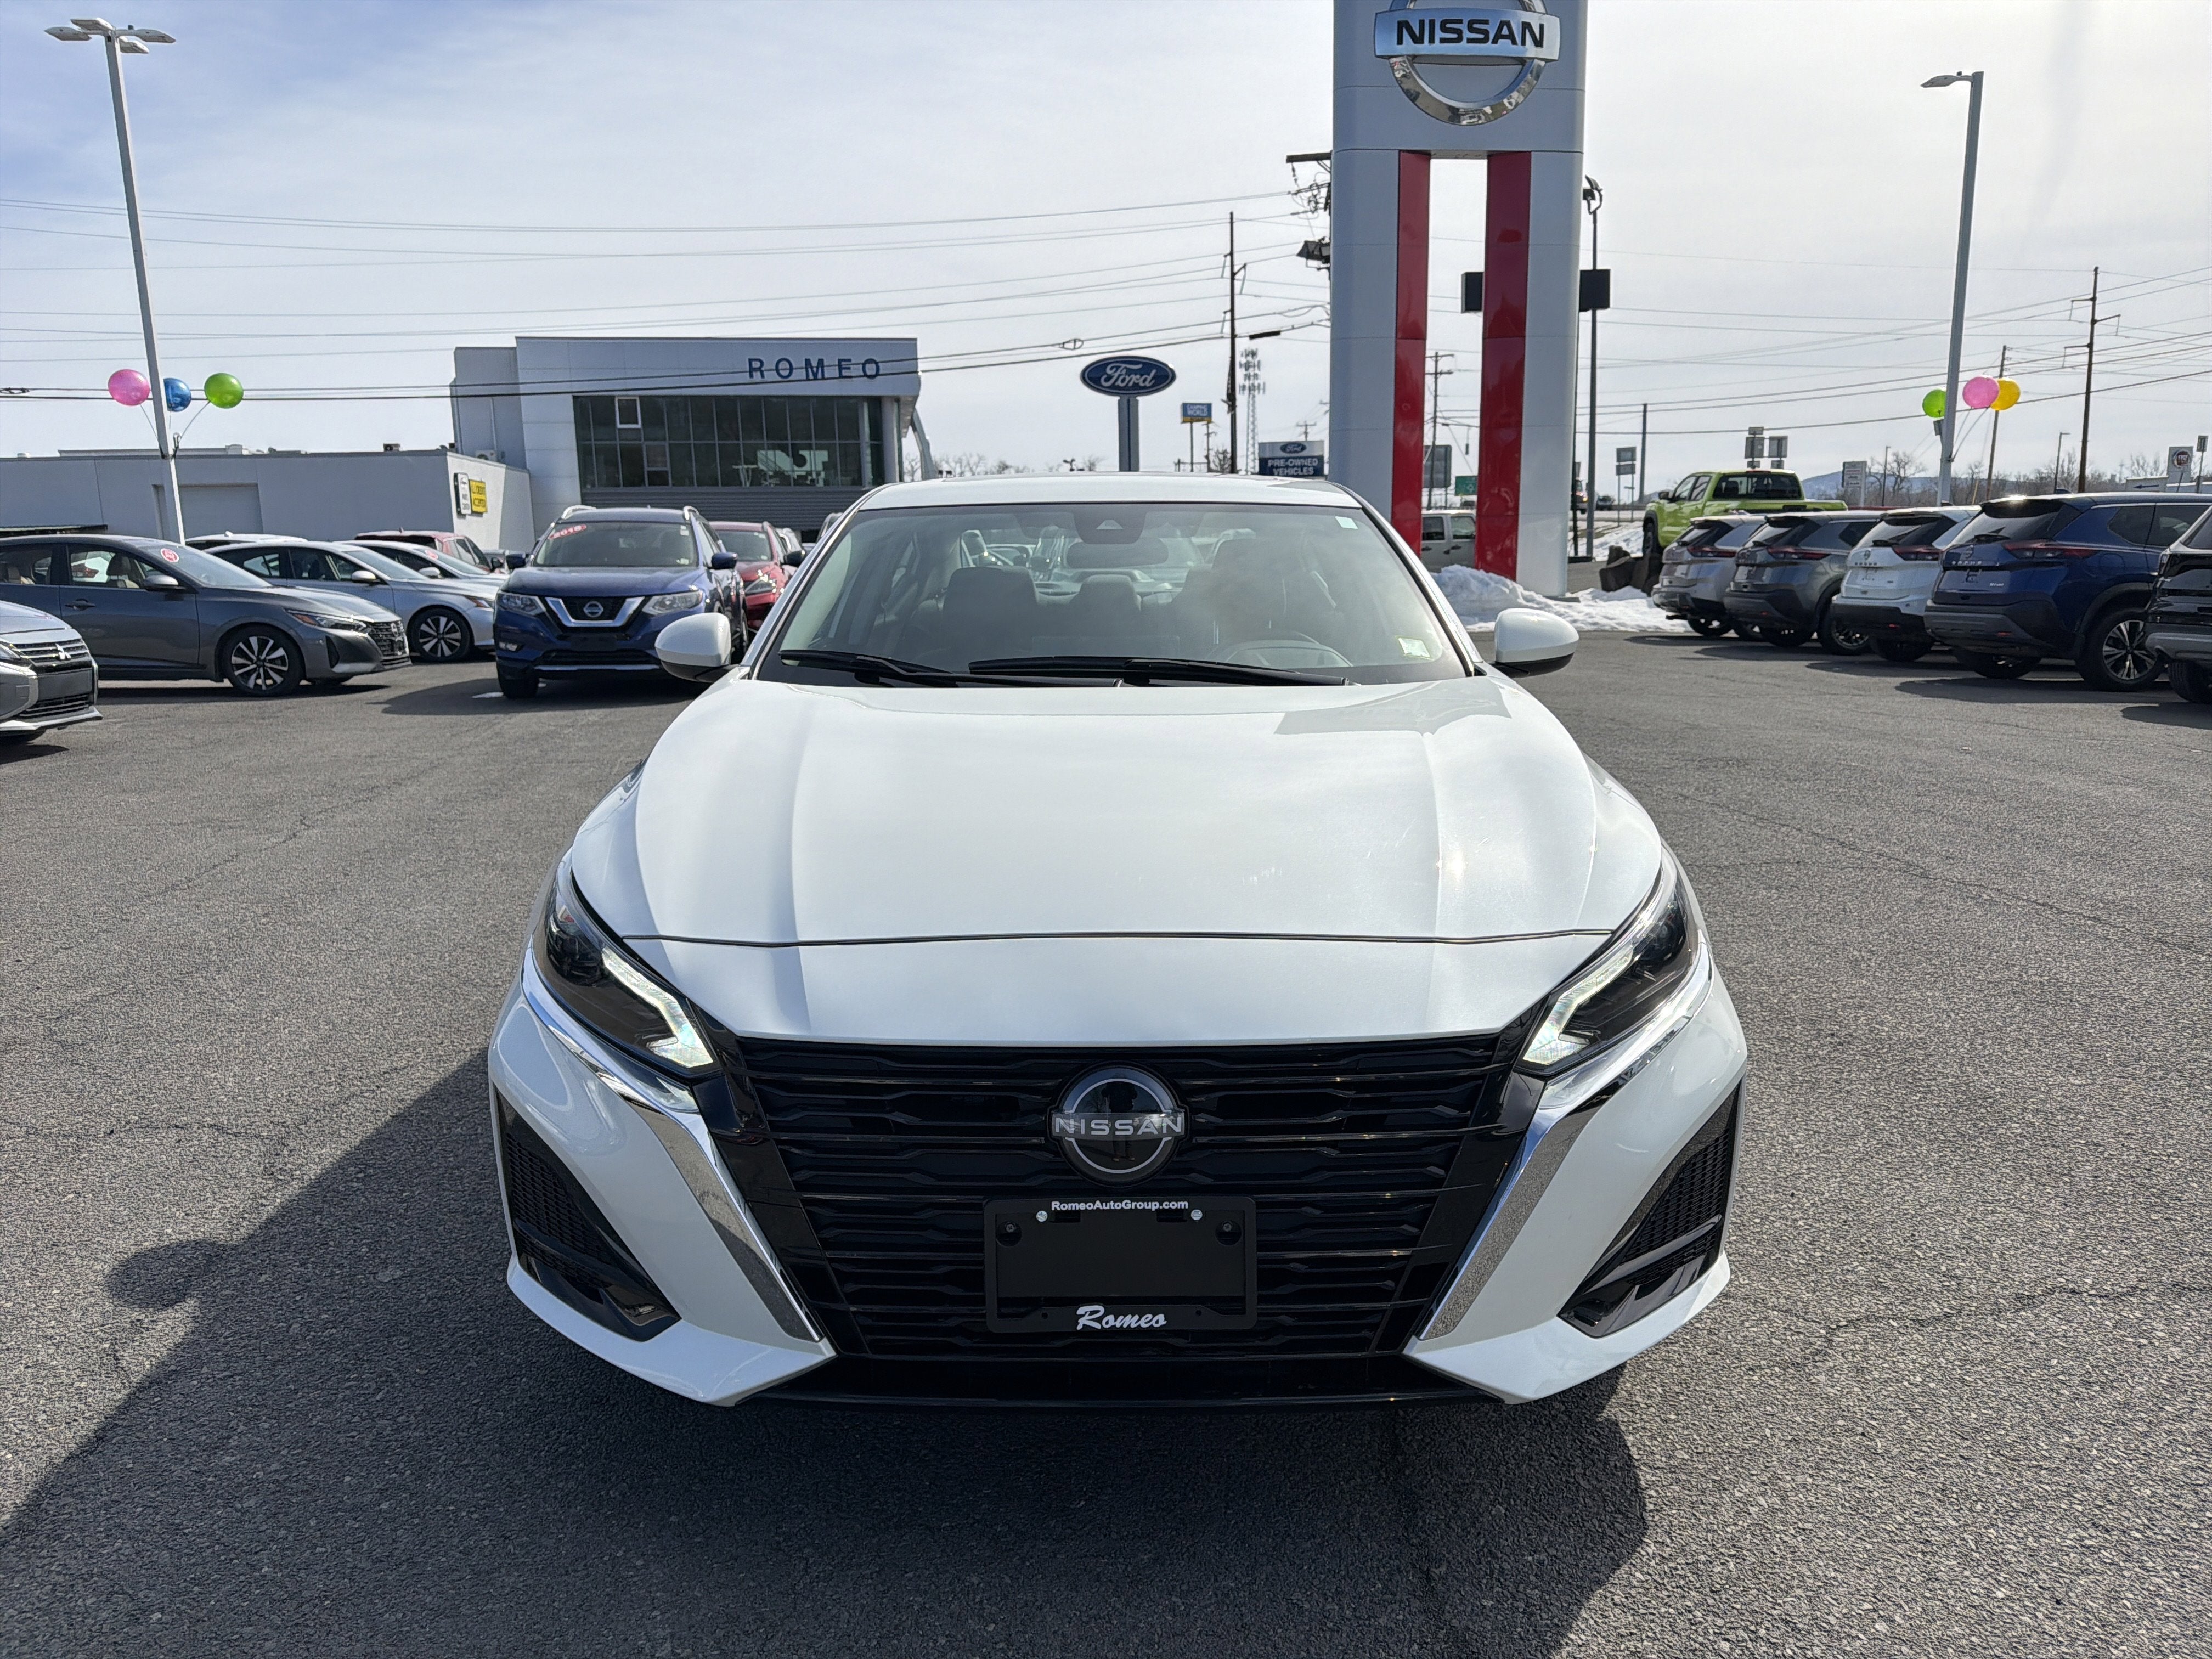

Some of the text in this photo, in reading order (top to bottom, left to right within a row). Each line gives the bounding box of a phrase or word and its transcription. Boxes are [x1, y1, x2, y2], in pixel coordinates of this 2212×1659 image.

[1396, 18, 1545, 48] NISSAN
[748, 357, 881, 380] ROMEO
[1100, 363, 1157, 387] Ford
[1267, 458, 1318, 467] PRE-OWNED
[1273, 466, 1314, 476] VEHICLES
[1055, 1116, 1182, 1136] NISSAN
[1051, 1199, 1189, 1211] RomeoAutoGroup.com
[1076, 1305, 1167, 1330] Romeo
